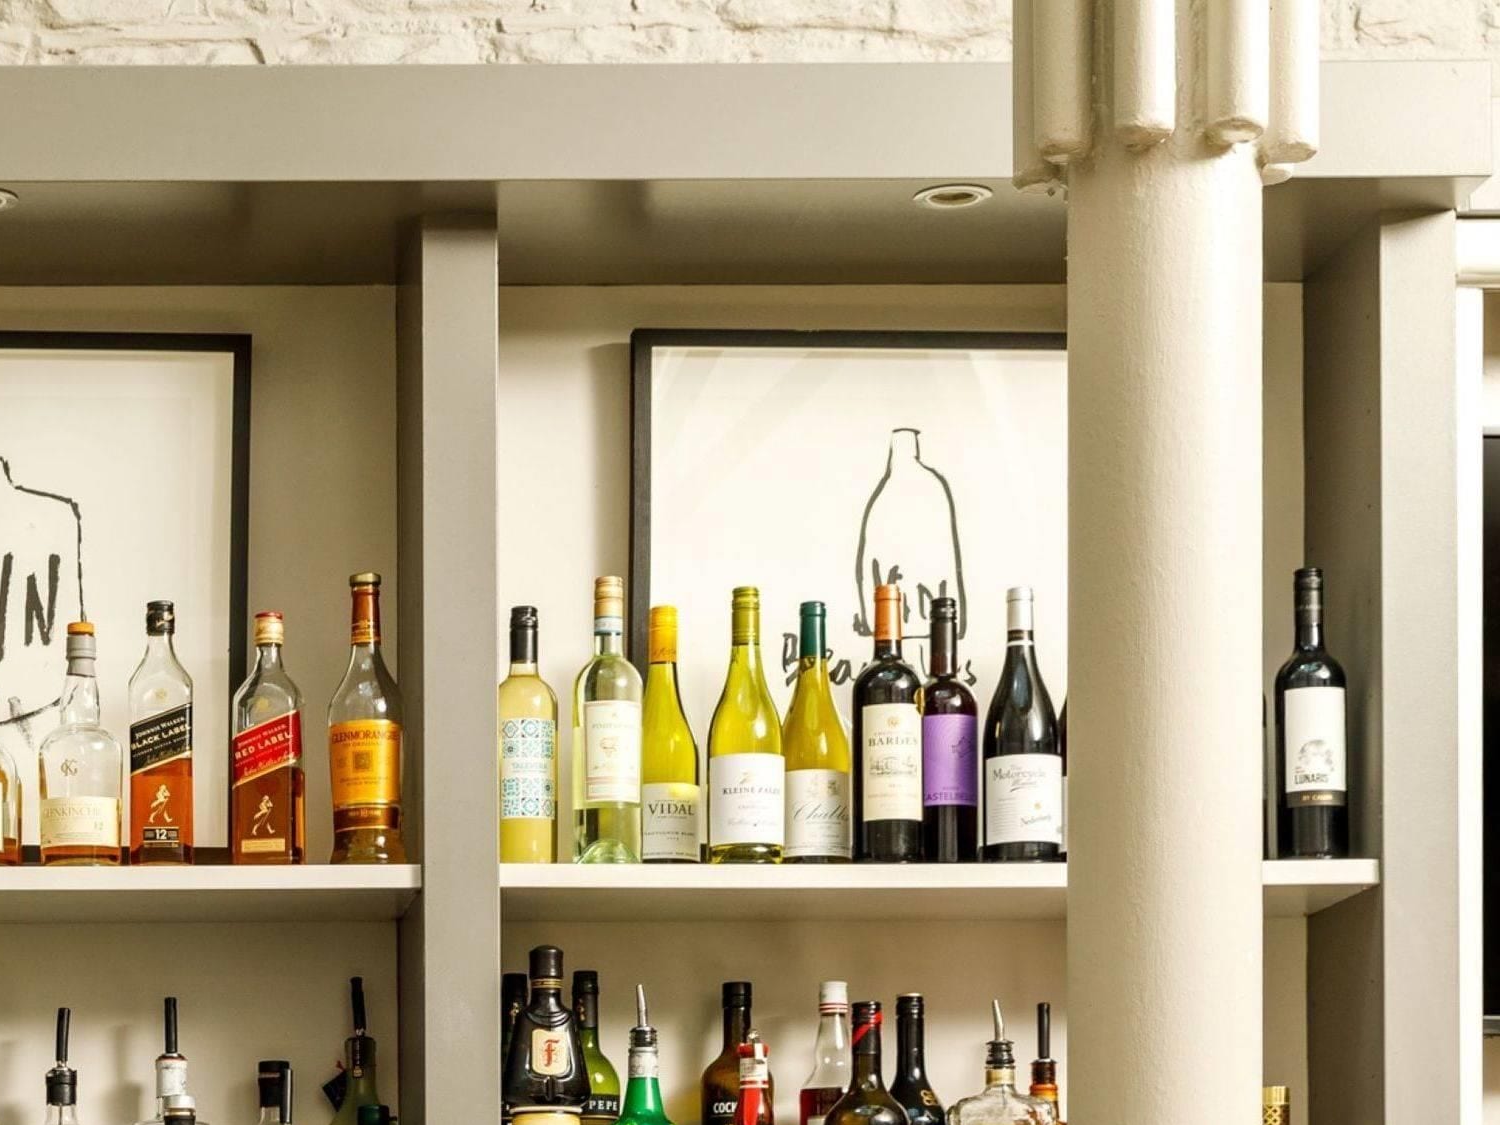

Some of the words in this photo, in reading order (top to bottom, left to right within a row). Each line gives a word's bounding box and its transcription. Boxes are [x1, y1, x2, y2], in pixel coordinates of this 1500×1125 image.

[131, 733, 161, 750] BLACK
[162, 724, 191, 740] LABEL
[235, 745, 256, 760] RED
[258, 732, 294, 749] LABEL
[723, 786, 755, 796] KLEINE
[649, 803, 695, 816] VIDAL
[155, 829, 167, 840] 12
